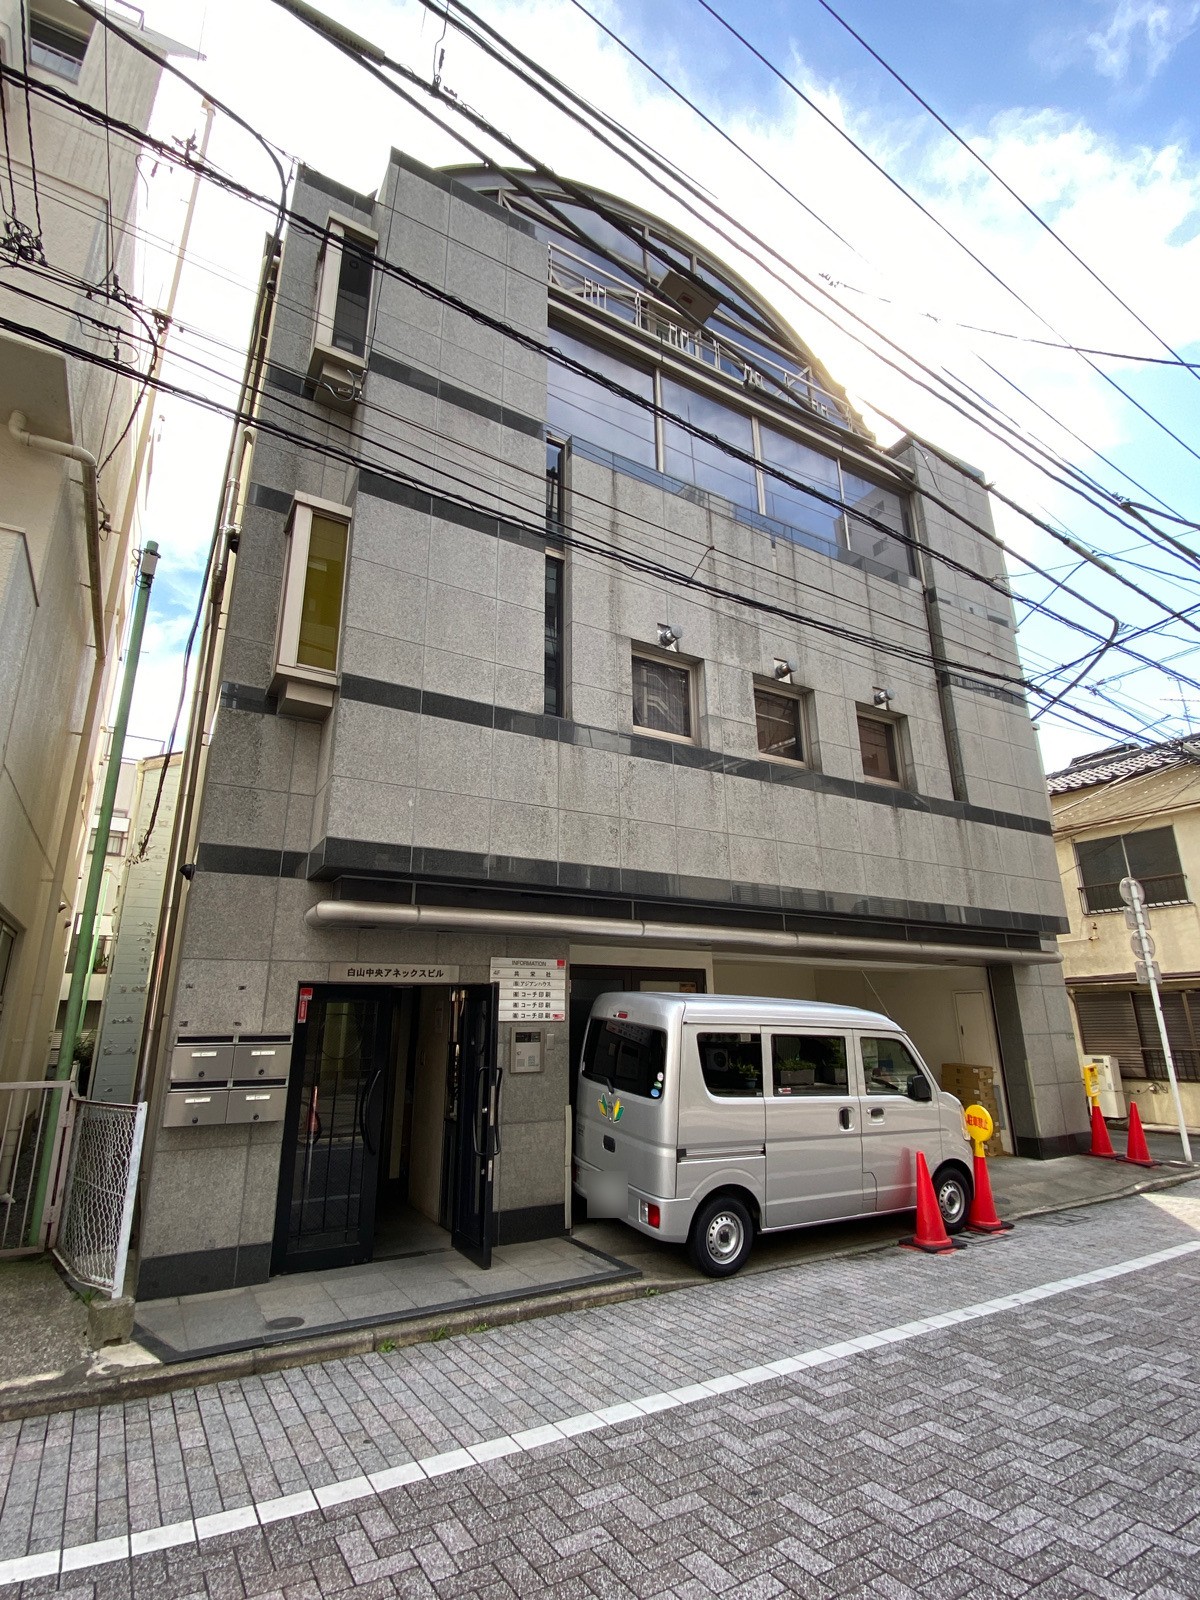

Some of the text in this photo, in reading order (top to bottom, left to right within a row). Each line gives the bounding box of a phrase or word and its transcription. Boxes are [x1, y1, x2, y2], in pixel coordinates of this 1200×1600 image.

[347, 967, 444, 978] 白山中央アネックスビル
